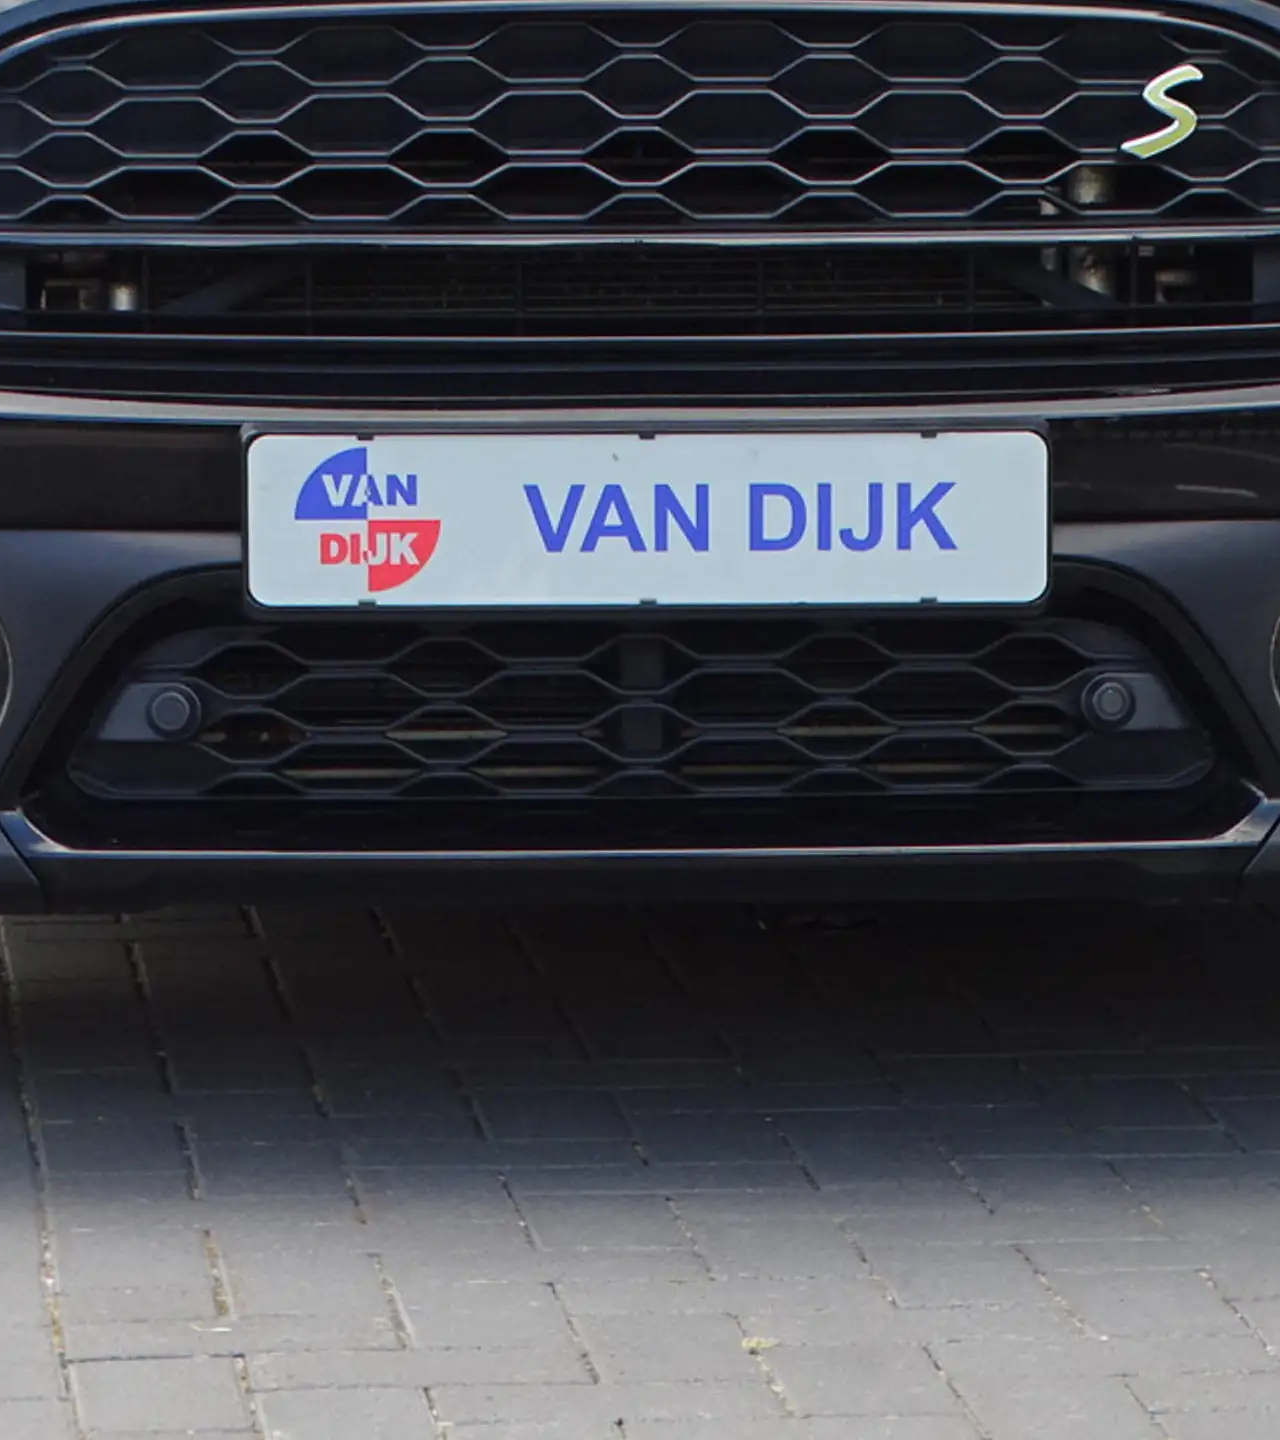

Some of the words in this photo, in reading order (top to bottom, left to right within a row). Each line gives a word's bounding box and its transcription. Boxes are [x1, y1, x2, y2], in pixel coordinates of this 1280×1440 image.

[1121, 64, 1204, 159] S
[321, 473, 418, 507] VAN
[522, 483, 710, 552] VAN
[748, 481, 959, 552] DIJK
[320, 532, 420, 566] DIJK
